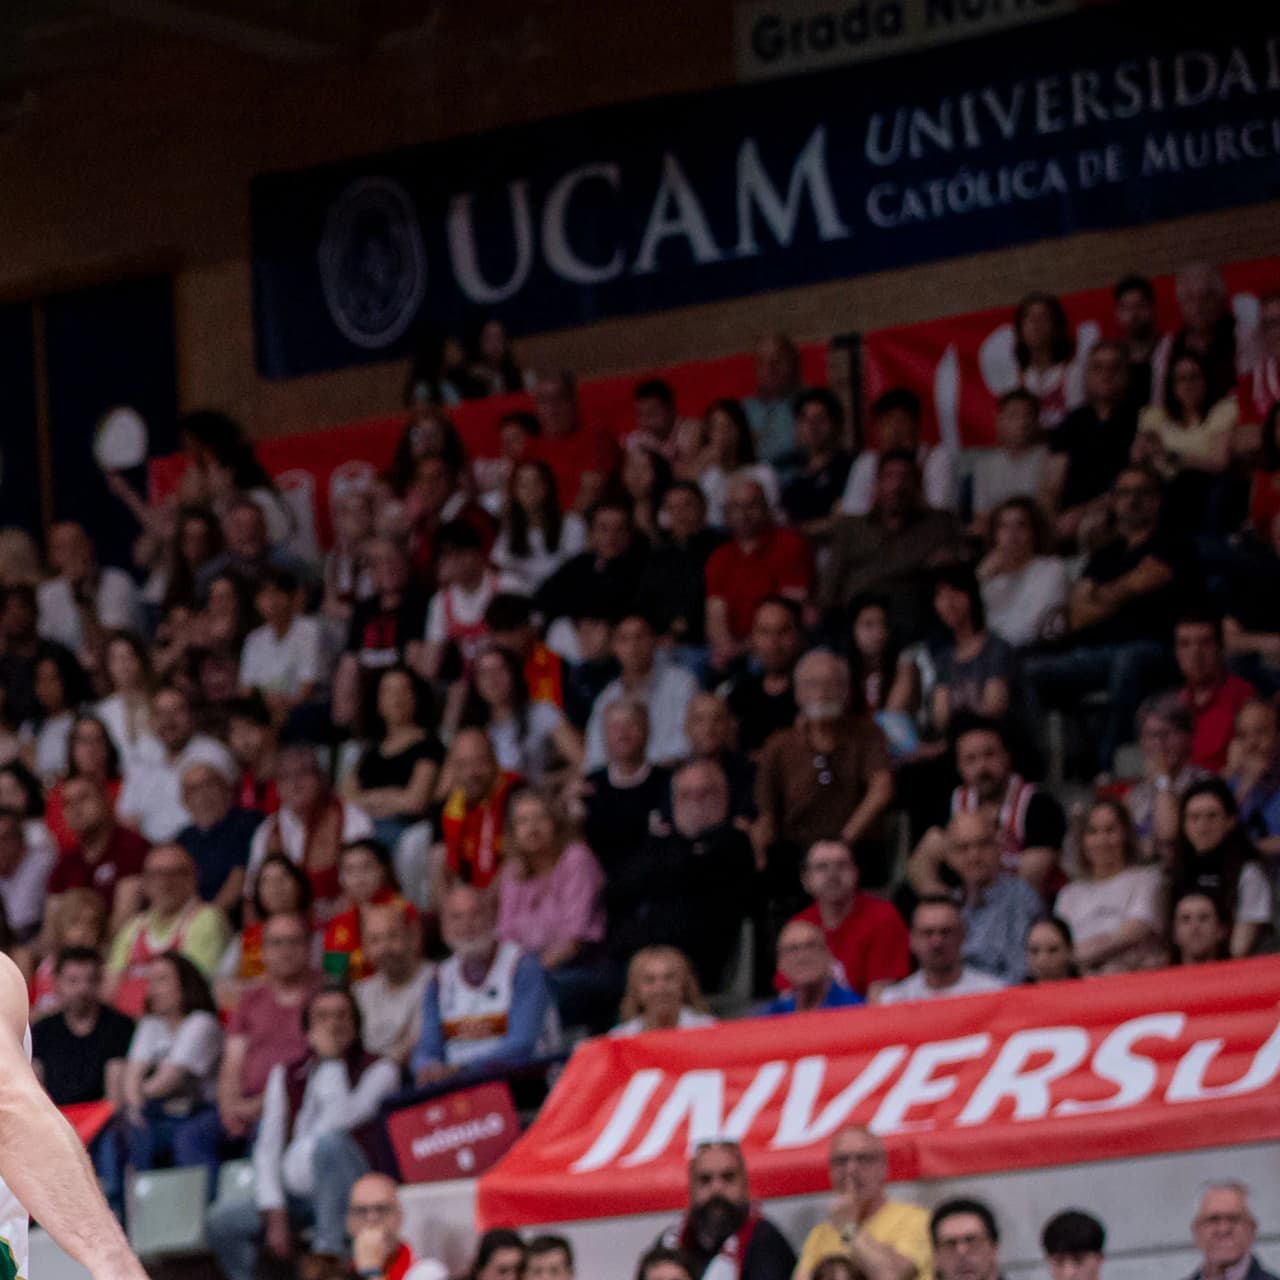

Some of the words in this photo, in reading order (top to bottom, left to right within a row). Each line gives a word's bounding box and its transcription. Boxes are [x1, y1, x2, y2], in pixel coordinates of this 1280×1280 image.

[751, 0, 903, 61] Grada
[1078, 144, 1128, 189] DE
[447, 123, 852, 305] UCAM
